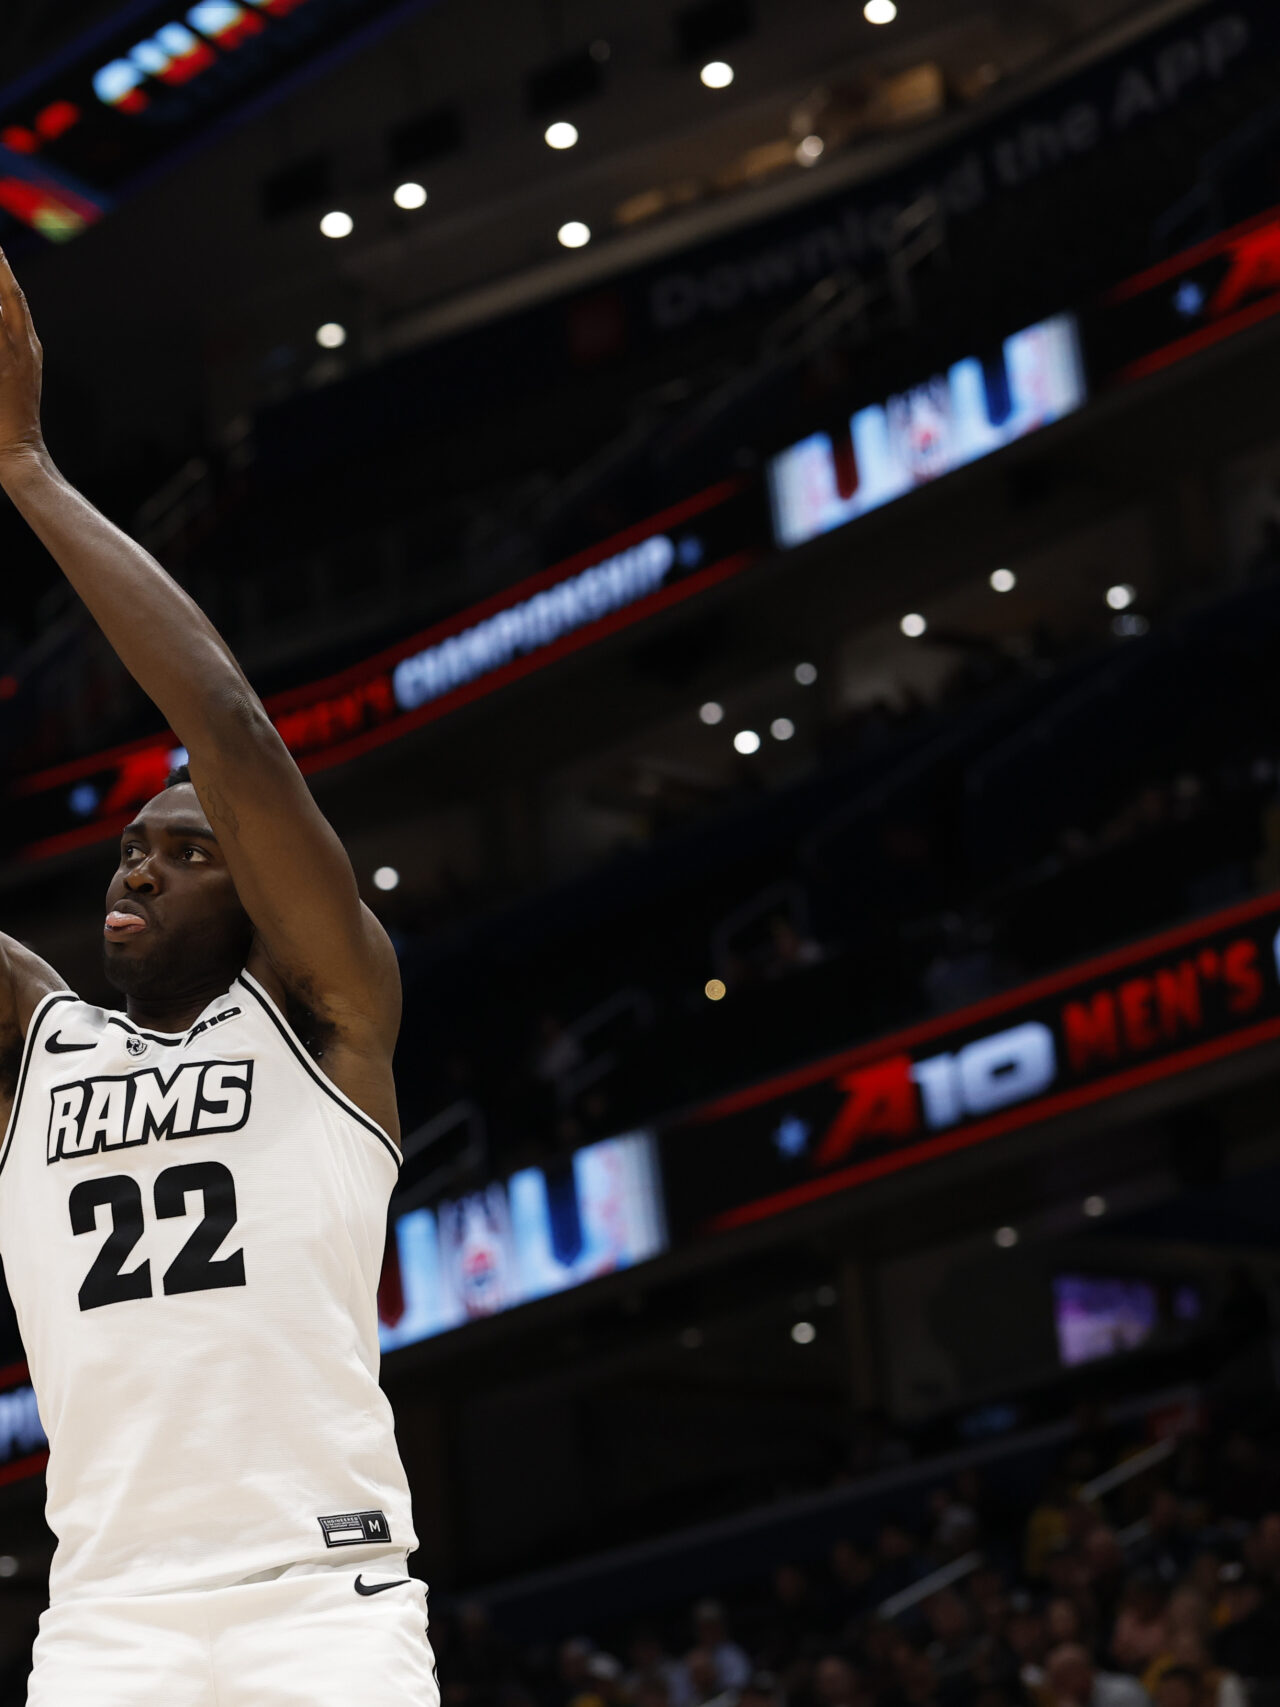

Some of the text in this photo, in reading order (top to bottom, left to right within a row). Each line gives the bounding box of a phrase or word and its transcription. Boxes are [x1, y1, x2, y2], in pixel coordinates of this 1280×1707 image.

[183, 1006, 242, 1047] A10
[814, 1018, 1058, 1168] A10
[1061, 938, 1263, 1073] MEN'S
[47, 1059, 255, 1166] RAMS
[68, 1160, 247, 1312] 22
[368, 1519, 381, 1533] M
